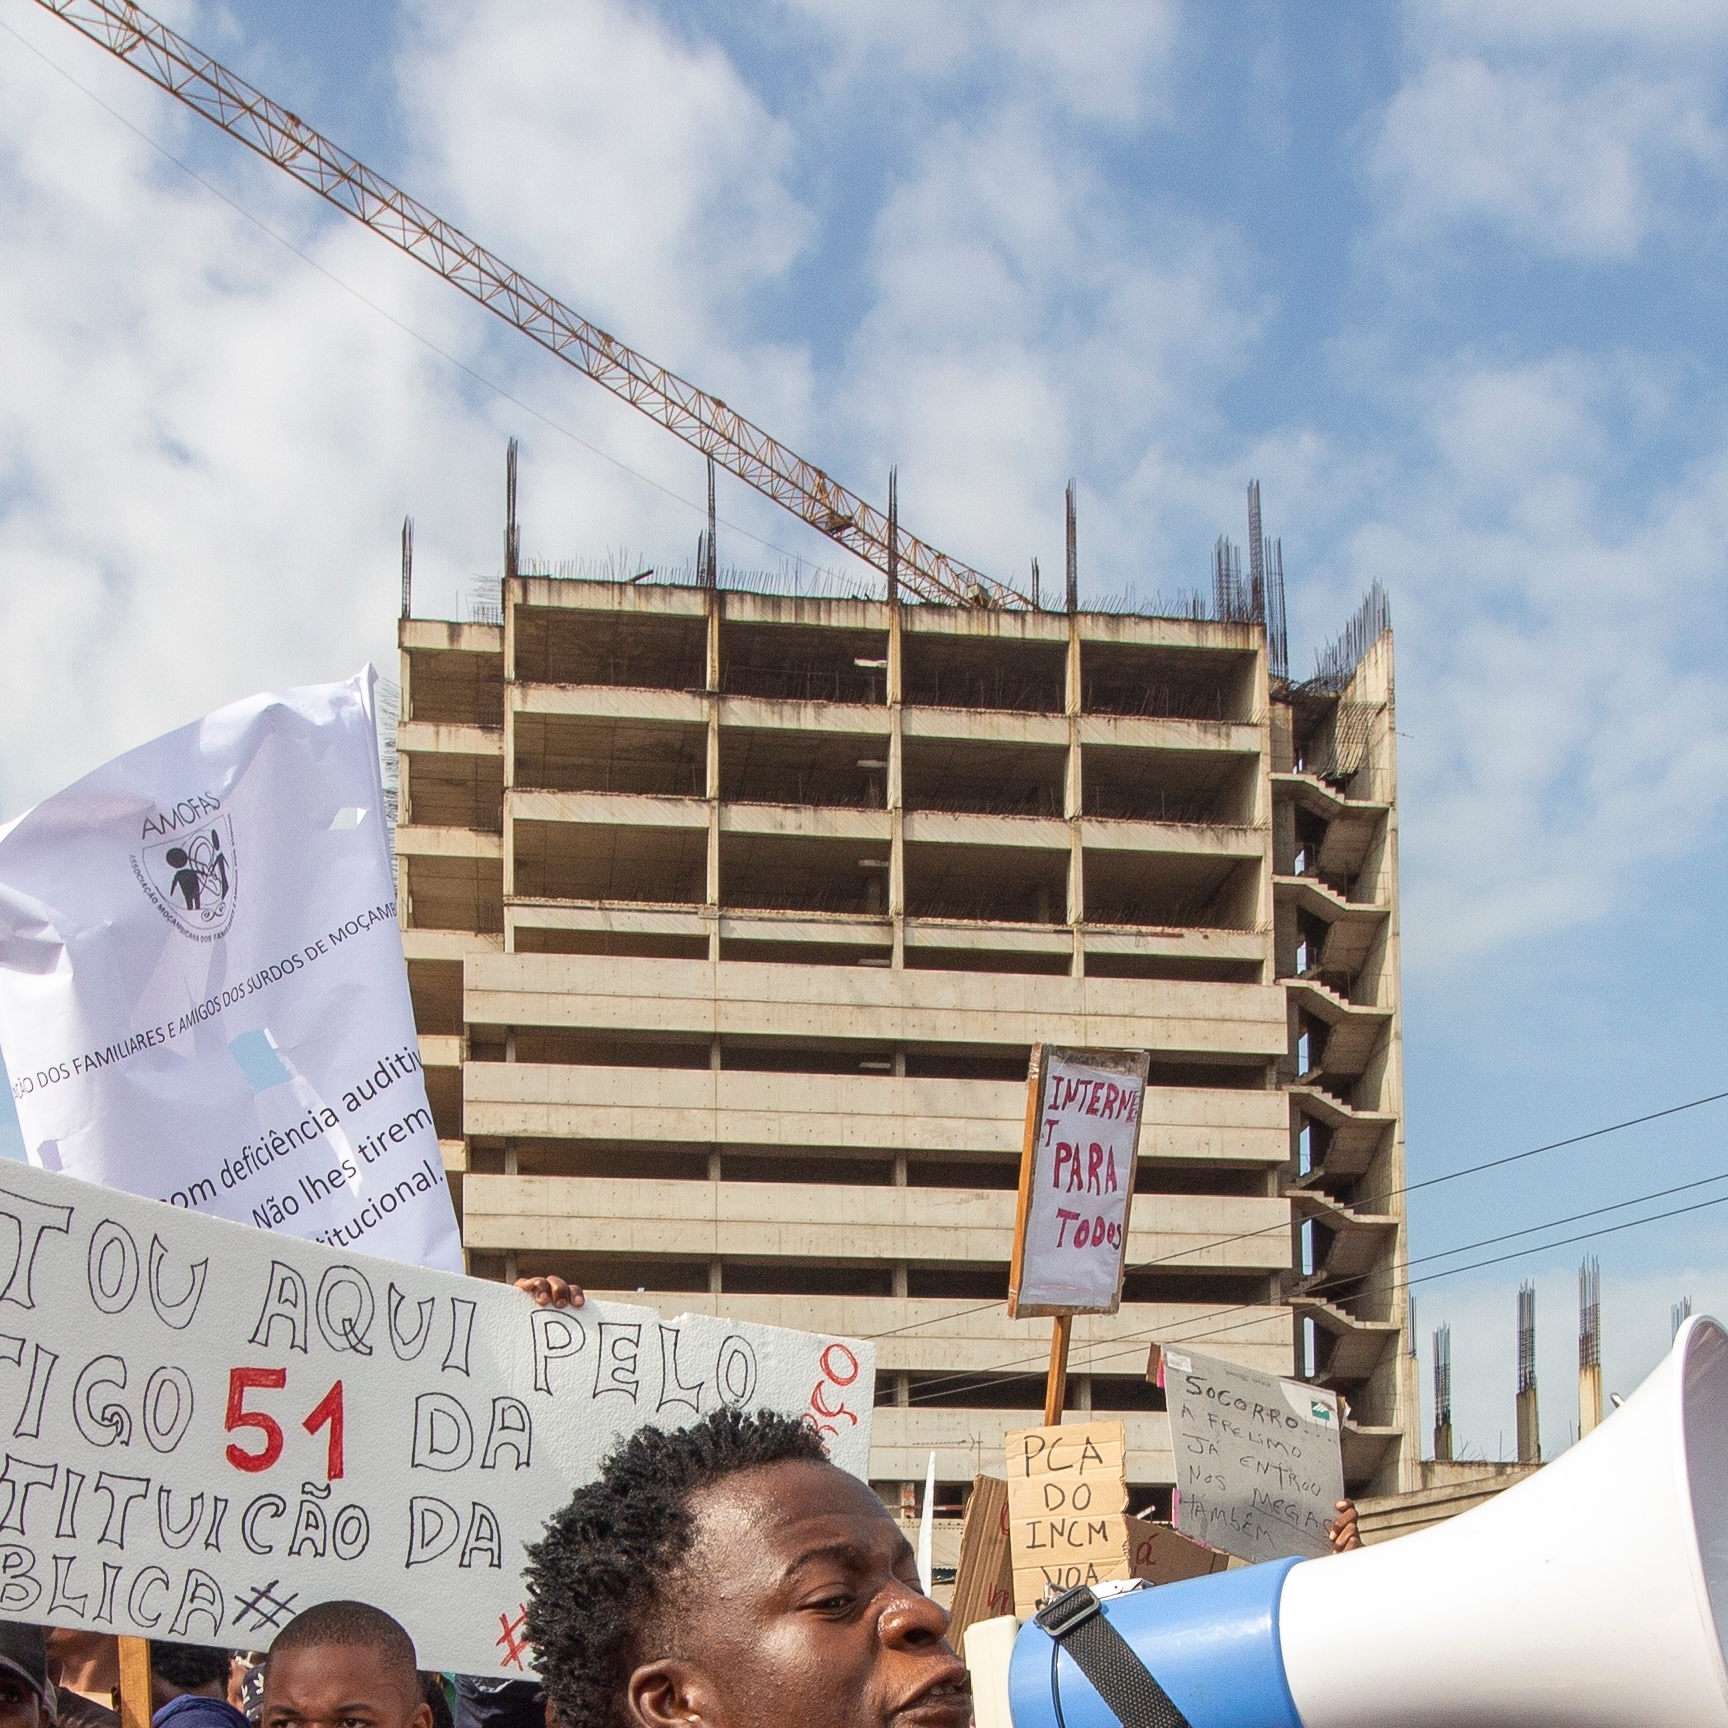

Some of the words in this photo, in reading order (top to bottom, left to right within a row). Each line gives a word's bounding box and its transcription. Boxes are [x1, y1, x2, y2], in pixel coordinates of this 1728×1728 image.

[142, 791, 221, 839] AMOFAS
[36, 1062, 71, 1093] DOS
[72, 1025, 166, 1075] FAMILIARES
[168, 1020, 177, 1039] E
[178, 997, 222, 1035] AMIGOS
[221, 986, 247, 1007] DOS
[246, 954, 305, 995] SURDOS
[304, 938, 330, 963] DE
[158, 1178, 217, 1209] om
[220, 1105, 340, 1189] deficiência
[251, 1193, 300, 1229] Não
[298, 1158, 357, 1204] lhes
[357, 1107, 433, 1163] tirem
[1053, 1142, 1118, 1196] PARA
[316, 1159, 444, 1248] itucional.
[1056, 1208, 1122, 1250] TODOS
[250, 1258, 478, 1376] AQUI
[530, 1309, 758, 1414] PELO
[224, 1366, 346, 1480] 51
[411, 1391, 533, 1472] DA
[1024, 1435, 1103, 1478] PCA
[405, 1494, 503, 1569] DA
[1025, 1518, 1108, 1549] INCM
[1043, 1483, 1092, 1511] DO
